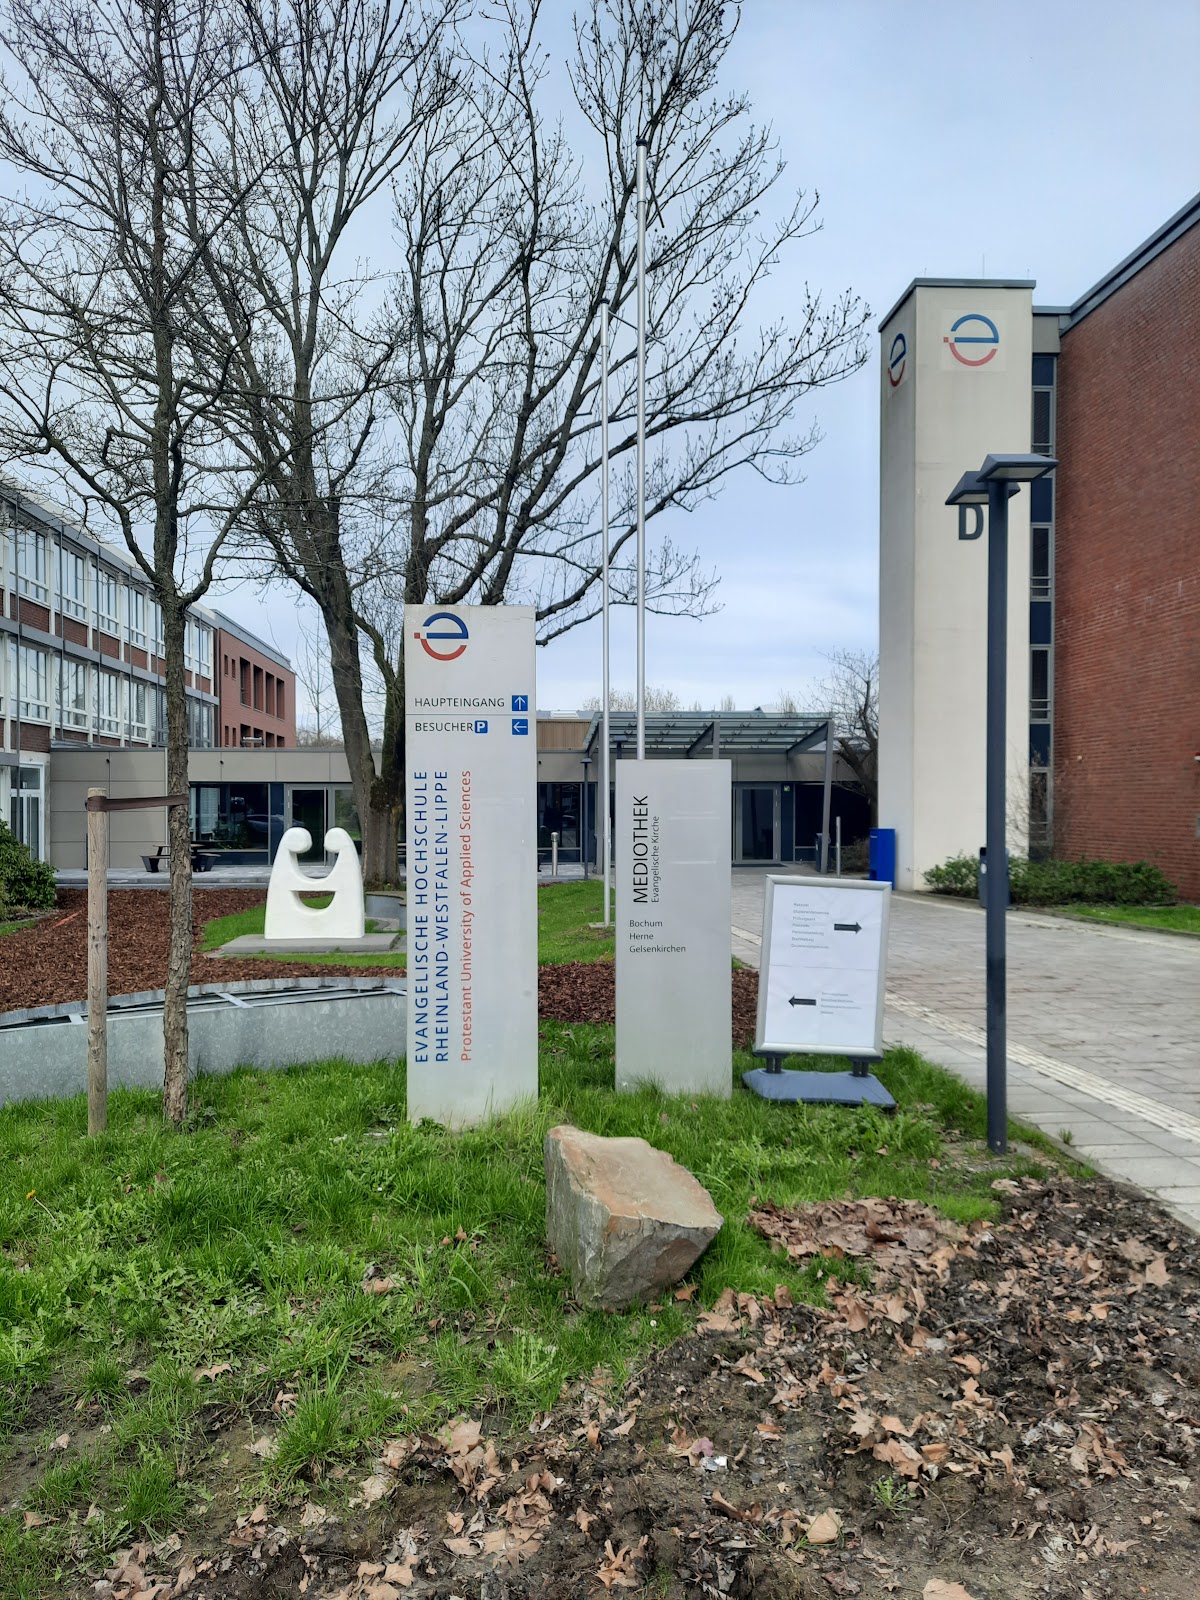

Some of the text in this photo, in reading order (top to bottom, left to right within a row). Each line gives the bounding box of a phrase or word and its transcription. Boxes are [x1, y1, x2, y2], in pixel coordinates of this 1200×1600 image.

[958, 503, 984, 540] D
[414, 697, 505, 707] HAUPTEINGANG
[415, 722, 474, 732] BESUCHER
[633, 795, 648, 903] MEDIOTHEK
[651, 815, 661, 903] Evangelische Kirche
[414, 771, 429, 1063] EVANGELISCHE HOCHSCHULE
[434, 771, 449, 1063] RHEINLAND-WESTFALEN-LIPPE
[459, 770, 475, 1062] Protestant University of Applied Sciences
[629, 919, 663, 928] Bochum
[629, 932, 654, 941] Herne
[629, 944, 687, 953] Gelsenkirchen
